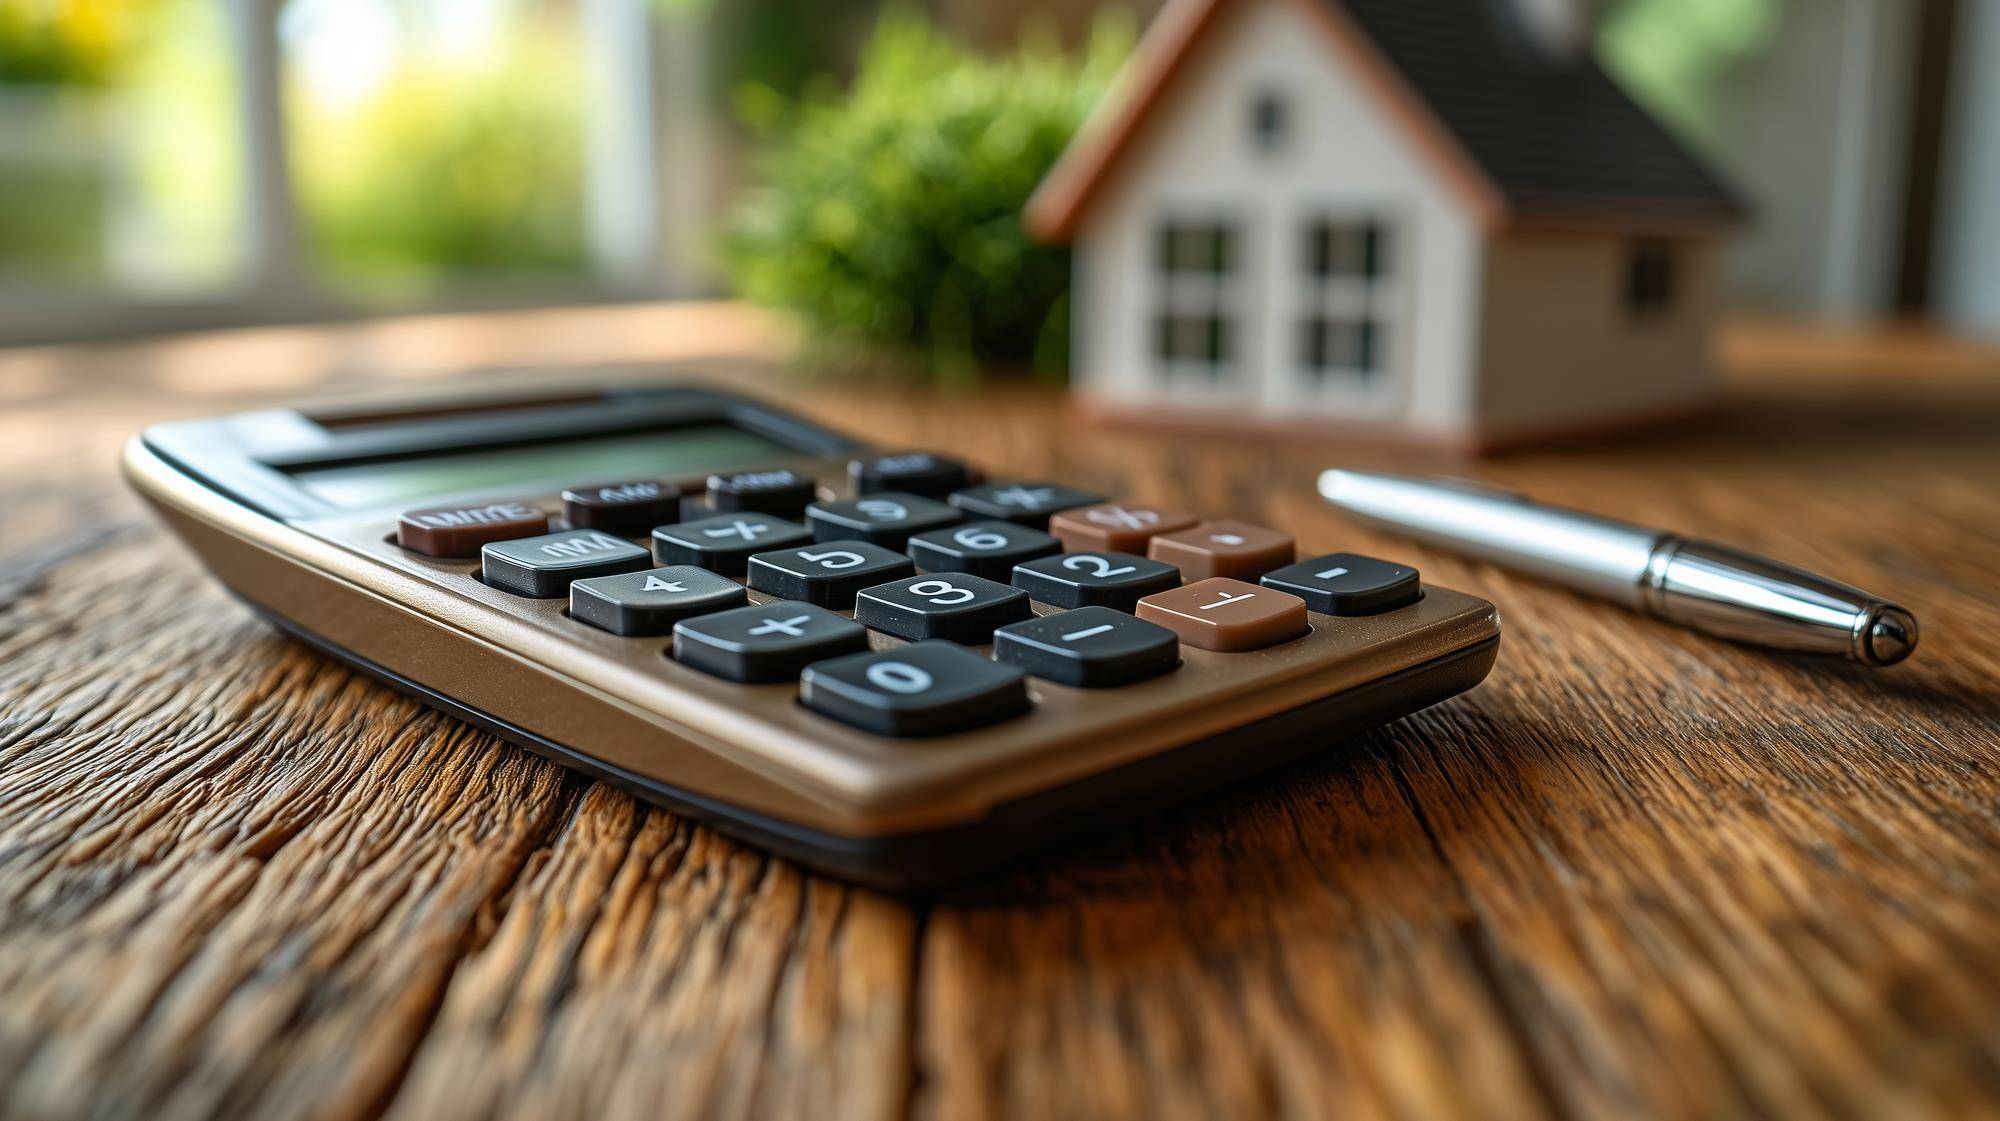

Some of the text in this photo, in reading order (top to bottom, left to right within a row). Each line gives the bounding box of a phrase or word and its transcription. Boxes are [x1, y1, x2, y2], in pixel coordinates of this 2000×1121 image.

[953, 528, 1008, 549] 6
[797, 551, 866, 568] 5
[1062, 555, 1137, 578] 2
[640, 575, 688, 592] 4
[866, 661, 933, 694] 0
